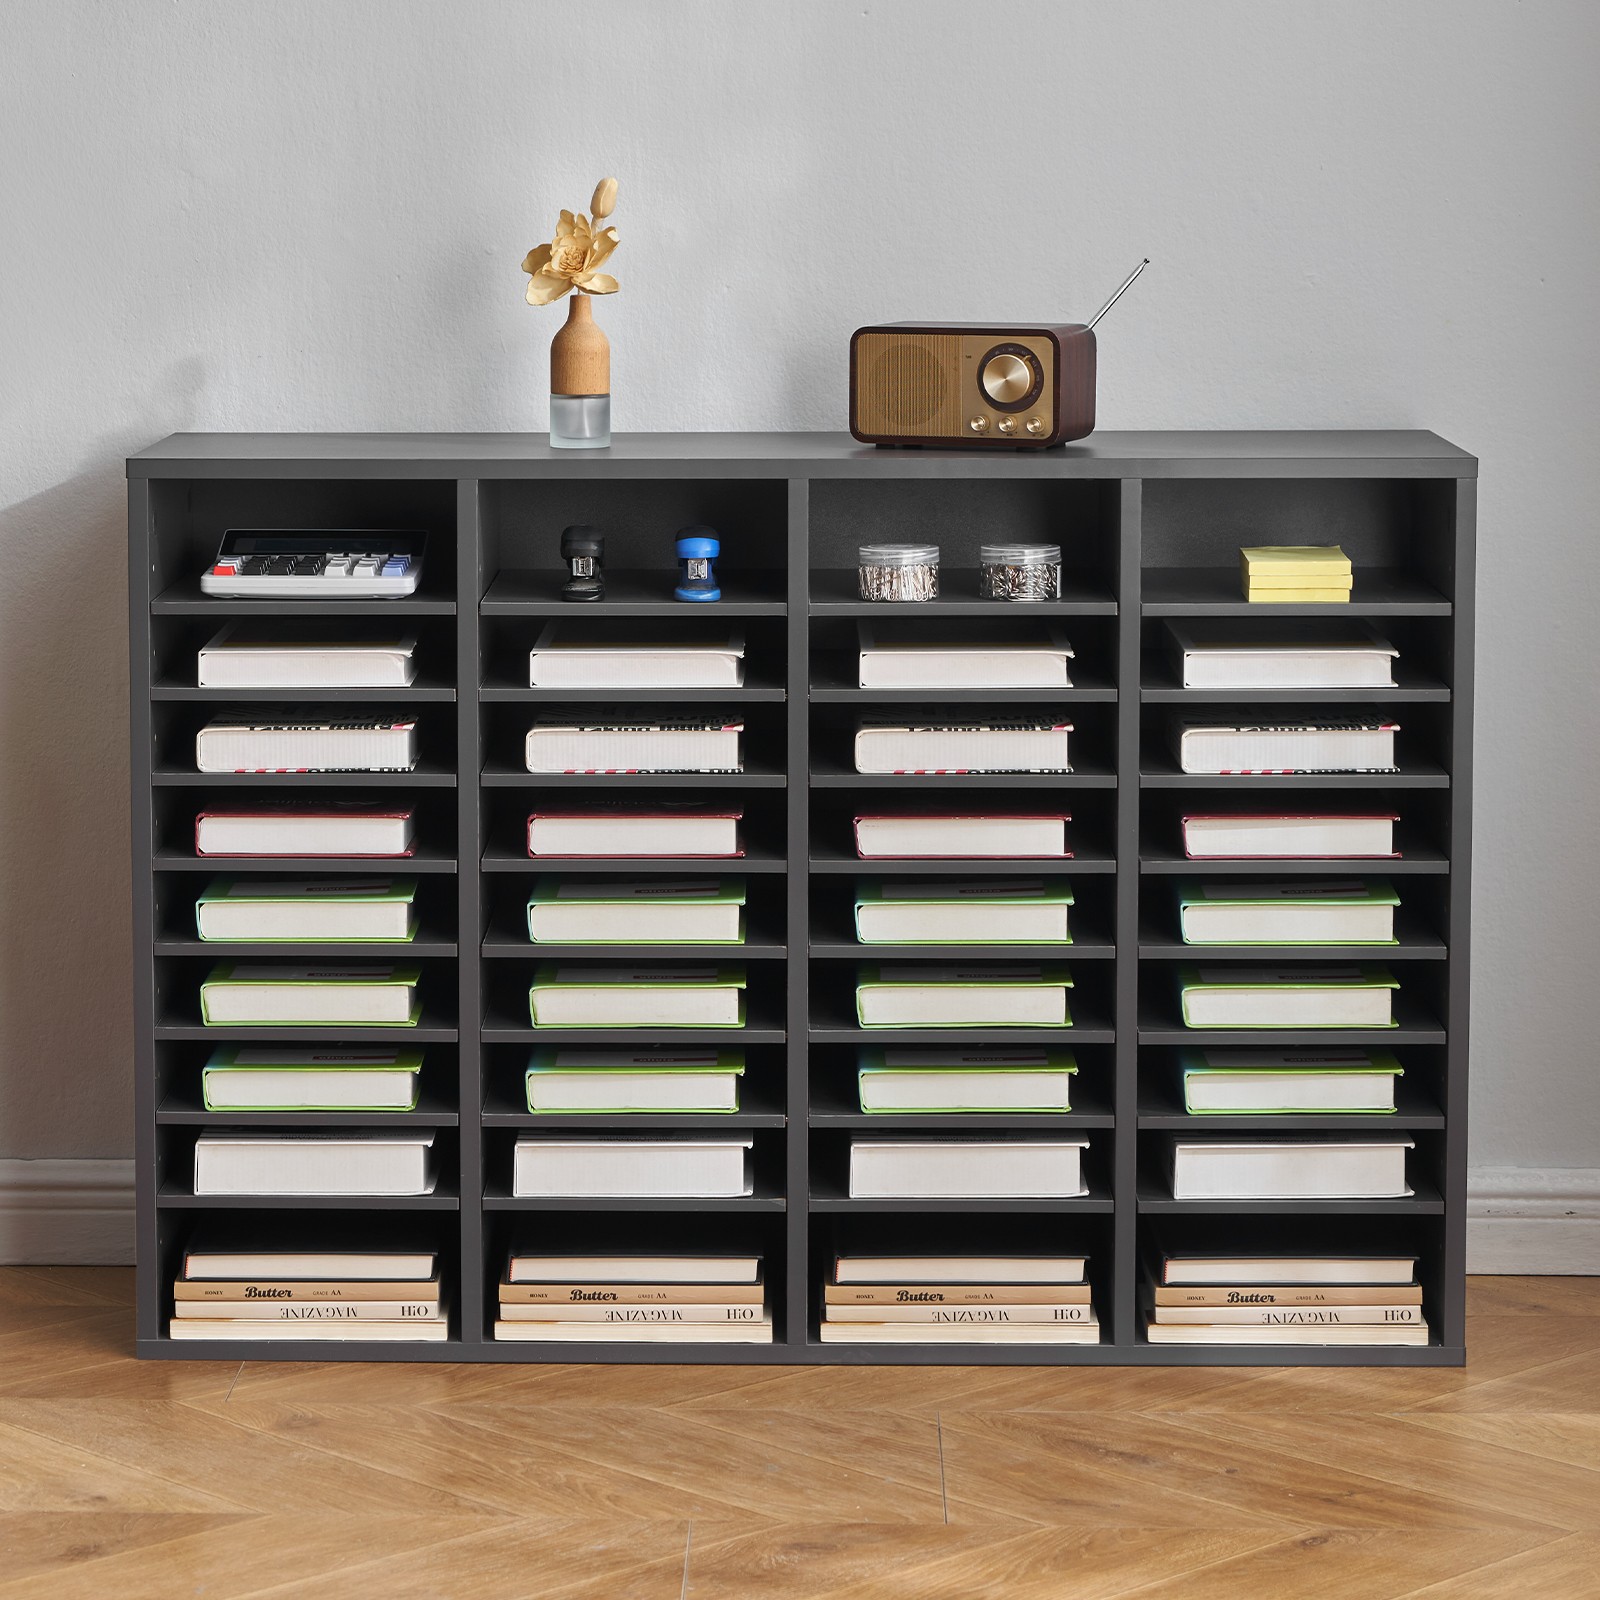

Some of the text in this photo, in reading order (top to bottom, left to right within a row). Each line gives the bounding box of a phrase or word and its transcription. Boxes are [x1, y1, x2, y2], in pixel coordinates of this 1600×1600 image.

[244, 1286, 293, 1298] Butter
[569, 1289, 618, 1301] Butter
[896, 1290, 945, 1302] Butter
[1227, 1291, 1276, 1304] Butter
[280, 1307, 358, 1318] MAGAZINE
[605, 1310, 683, 1321] MAGAZINE
[931, 1311, 1010, 1322] MAGAZINE
[1262, 1312, 1341, 1324] MAGAZINE
